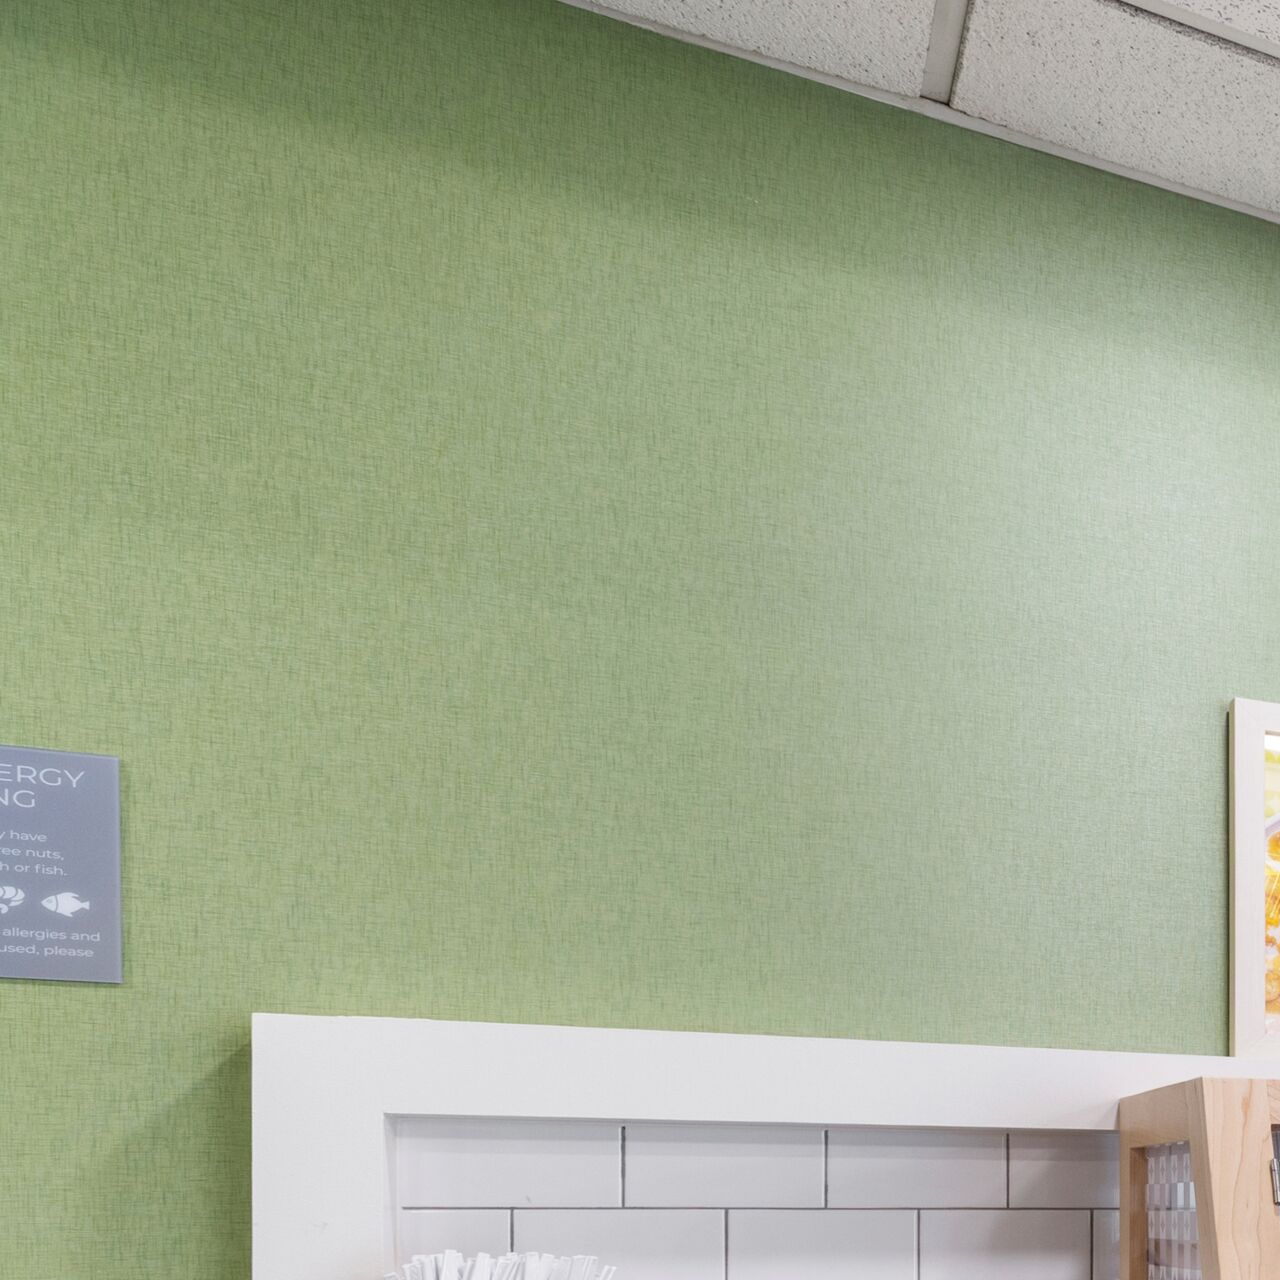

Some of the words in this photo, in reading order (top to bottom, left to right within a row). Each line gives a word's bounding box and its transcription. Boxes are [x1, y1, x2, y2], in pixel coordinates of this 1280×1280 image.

[10, 829, 48, 842] have
[0, 846, 21, 856] ee
[26, 849, 65, 861] nuts,
[14, 864, 30, 873] or
[34, 863, 68, 876] fish.
[2, 927, 67, 941] allergies
[70, 932, 101, 942] and
[44, 946, 95, 957] please
